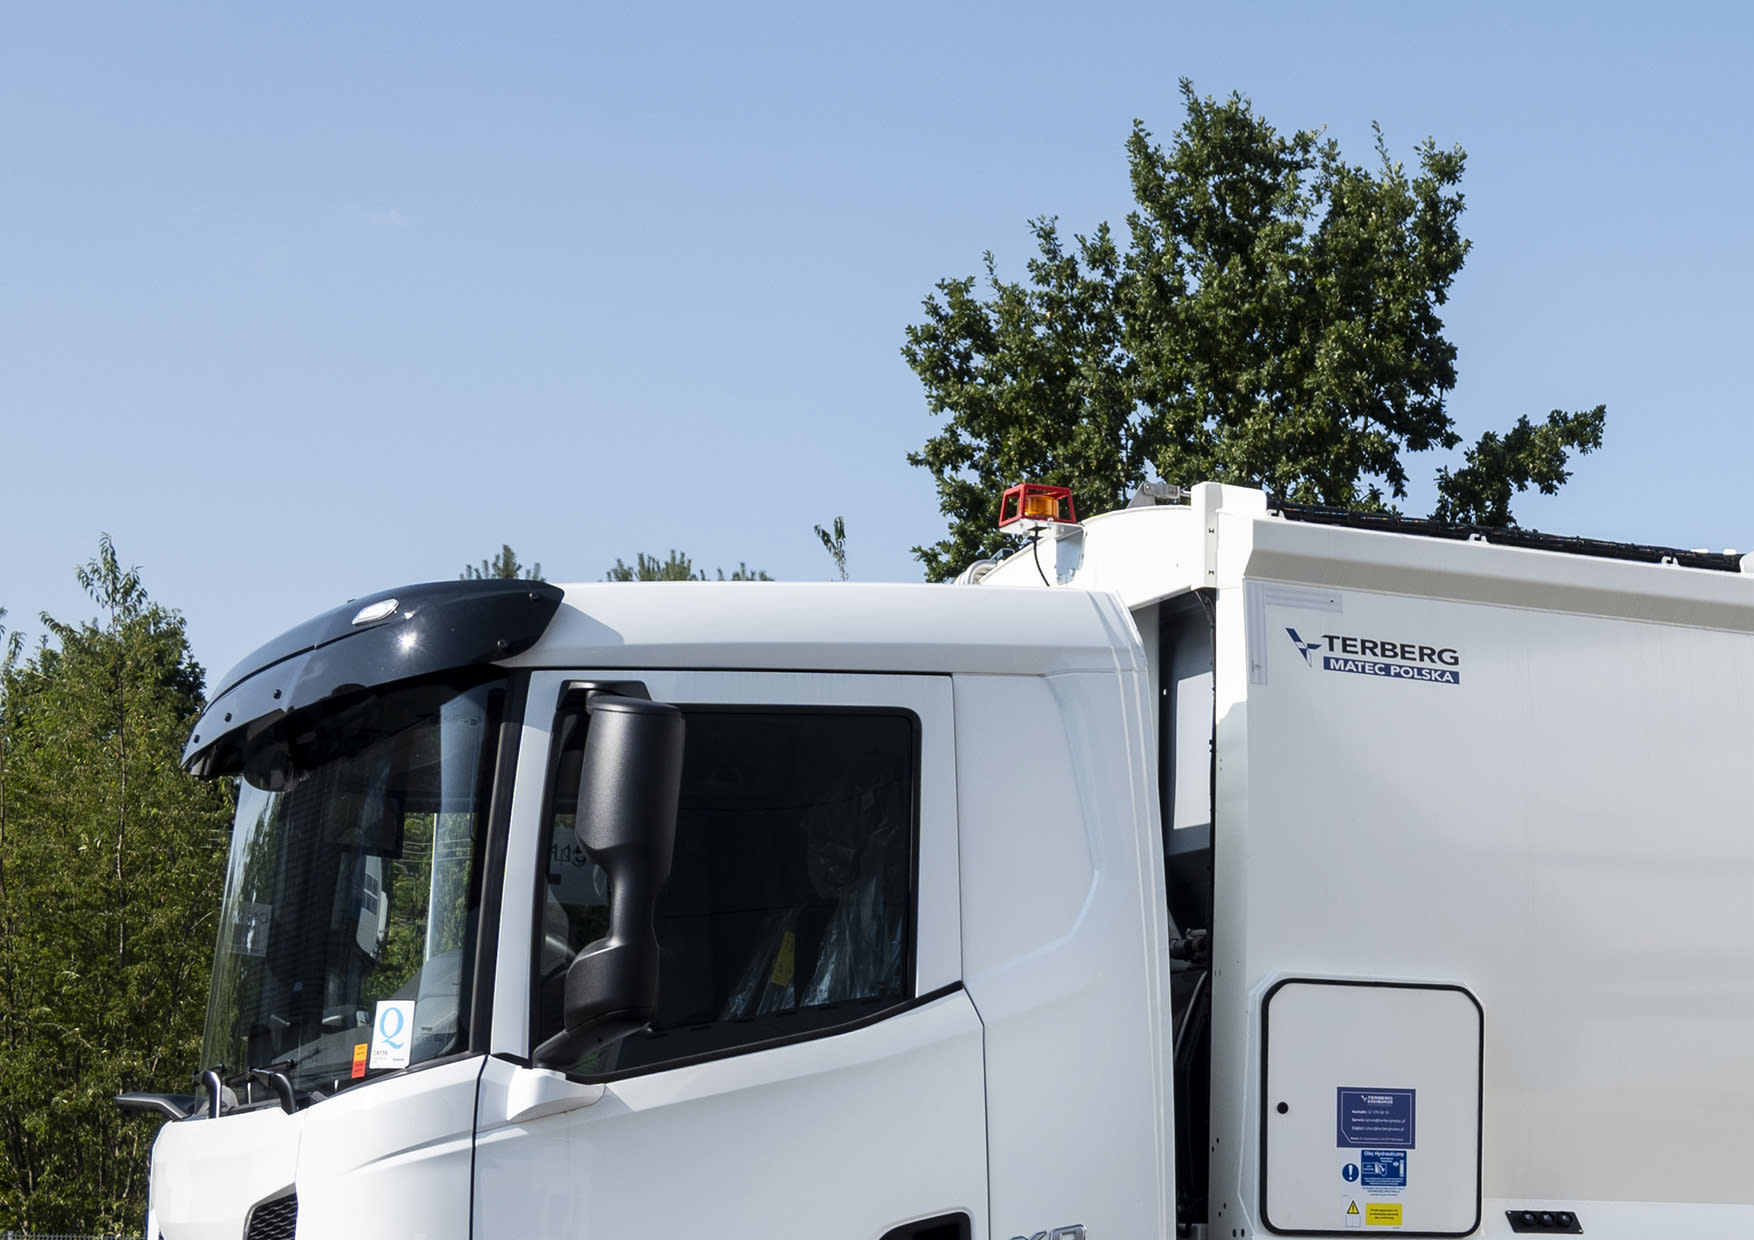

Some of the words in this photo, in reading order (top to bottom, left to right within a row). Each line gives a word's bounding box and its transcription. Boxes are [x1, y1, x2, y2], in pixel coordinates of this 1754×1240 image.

[1321, 634, 1460, 666] TERBERG
[1330, 658, 1385, 676] MATEC
[1390, 664, 1454, 683] POLSKA
[379, 1007, 405, 1049] Q
